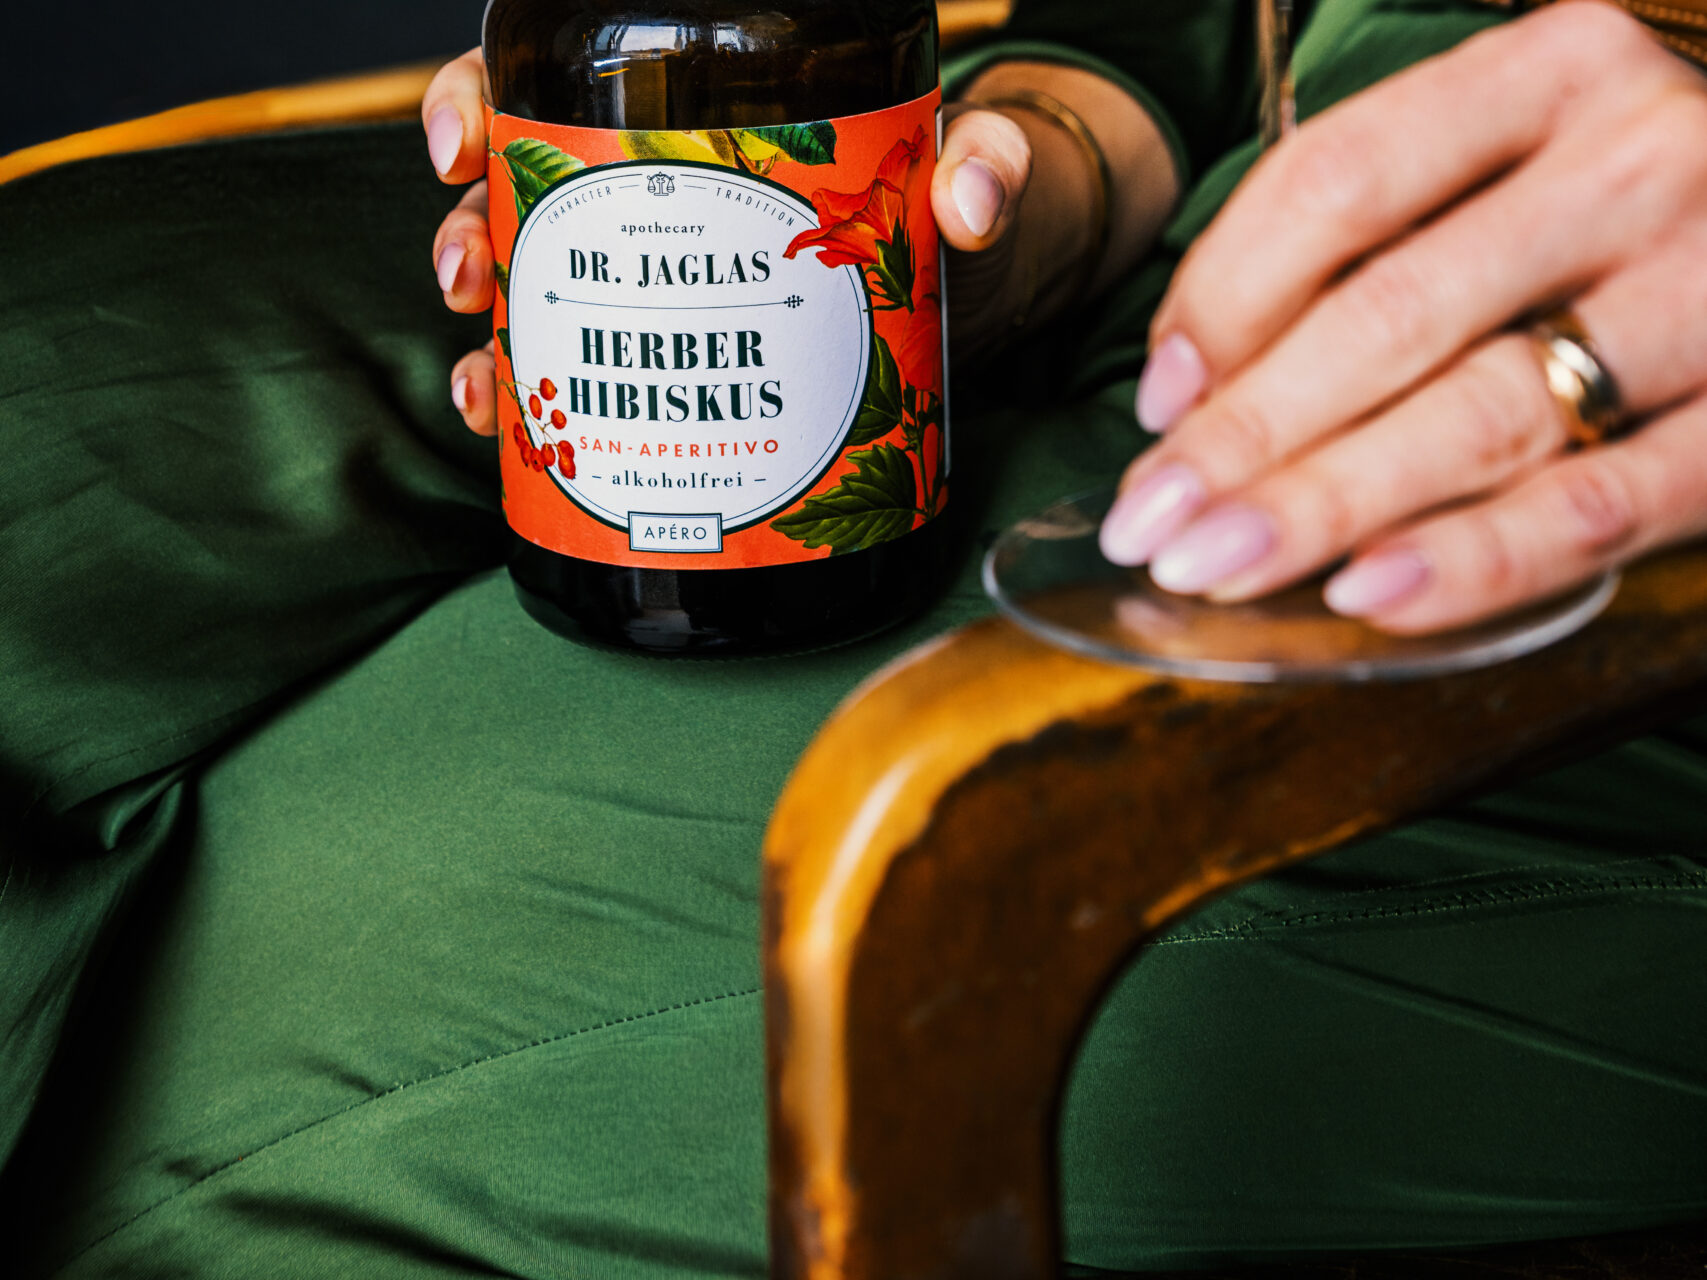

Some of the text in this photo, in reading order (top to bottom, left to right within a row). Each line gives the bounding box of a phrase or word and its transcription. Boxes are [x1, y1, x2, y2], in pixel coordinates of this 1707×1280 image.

[548, 186, 611, 224] CHARACTER
[716, 188, 794, 226] TRADITION
[621, 222, 705, 236] apothecary
[569, 248, 771, 288] DR. JAGLAS
[580, 327, 765, 370] HERBER
[569, 377, 783, 422] HIBISKUS
[580, 436, 779, 458] SAN-APERITIVO
[612, 470, 743, 488] alkoholfrei
[644, 524, 707, 540] APÉRO
